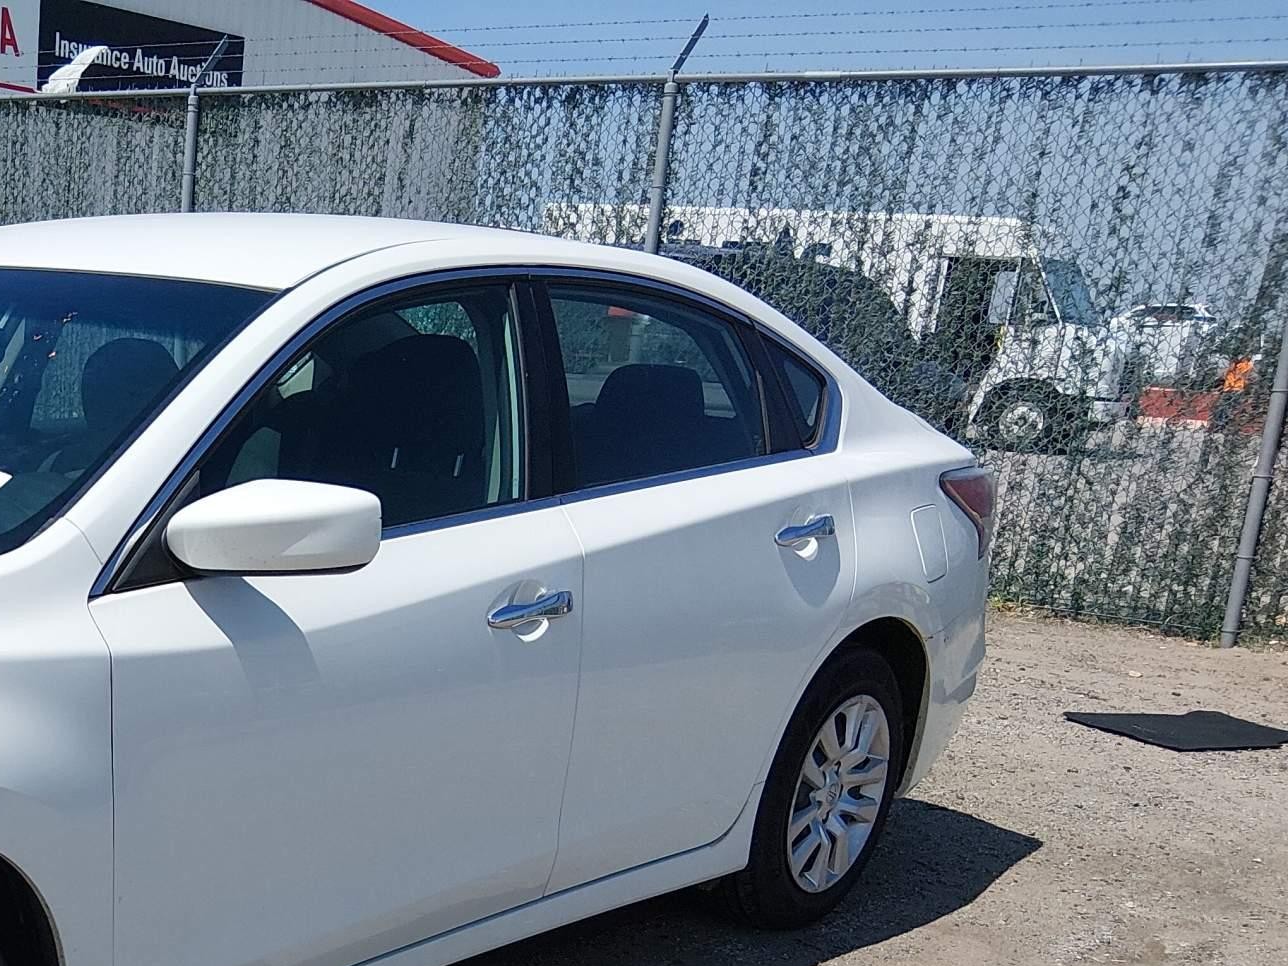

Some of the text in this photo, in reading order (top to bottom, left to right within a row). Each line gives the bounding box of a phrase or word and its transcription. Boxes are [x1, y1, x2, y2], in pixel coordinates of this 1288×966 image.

[54, 31, 229, 88] Insance Auto Auctons
